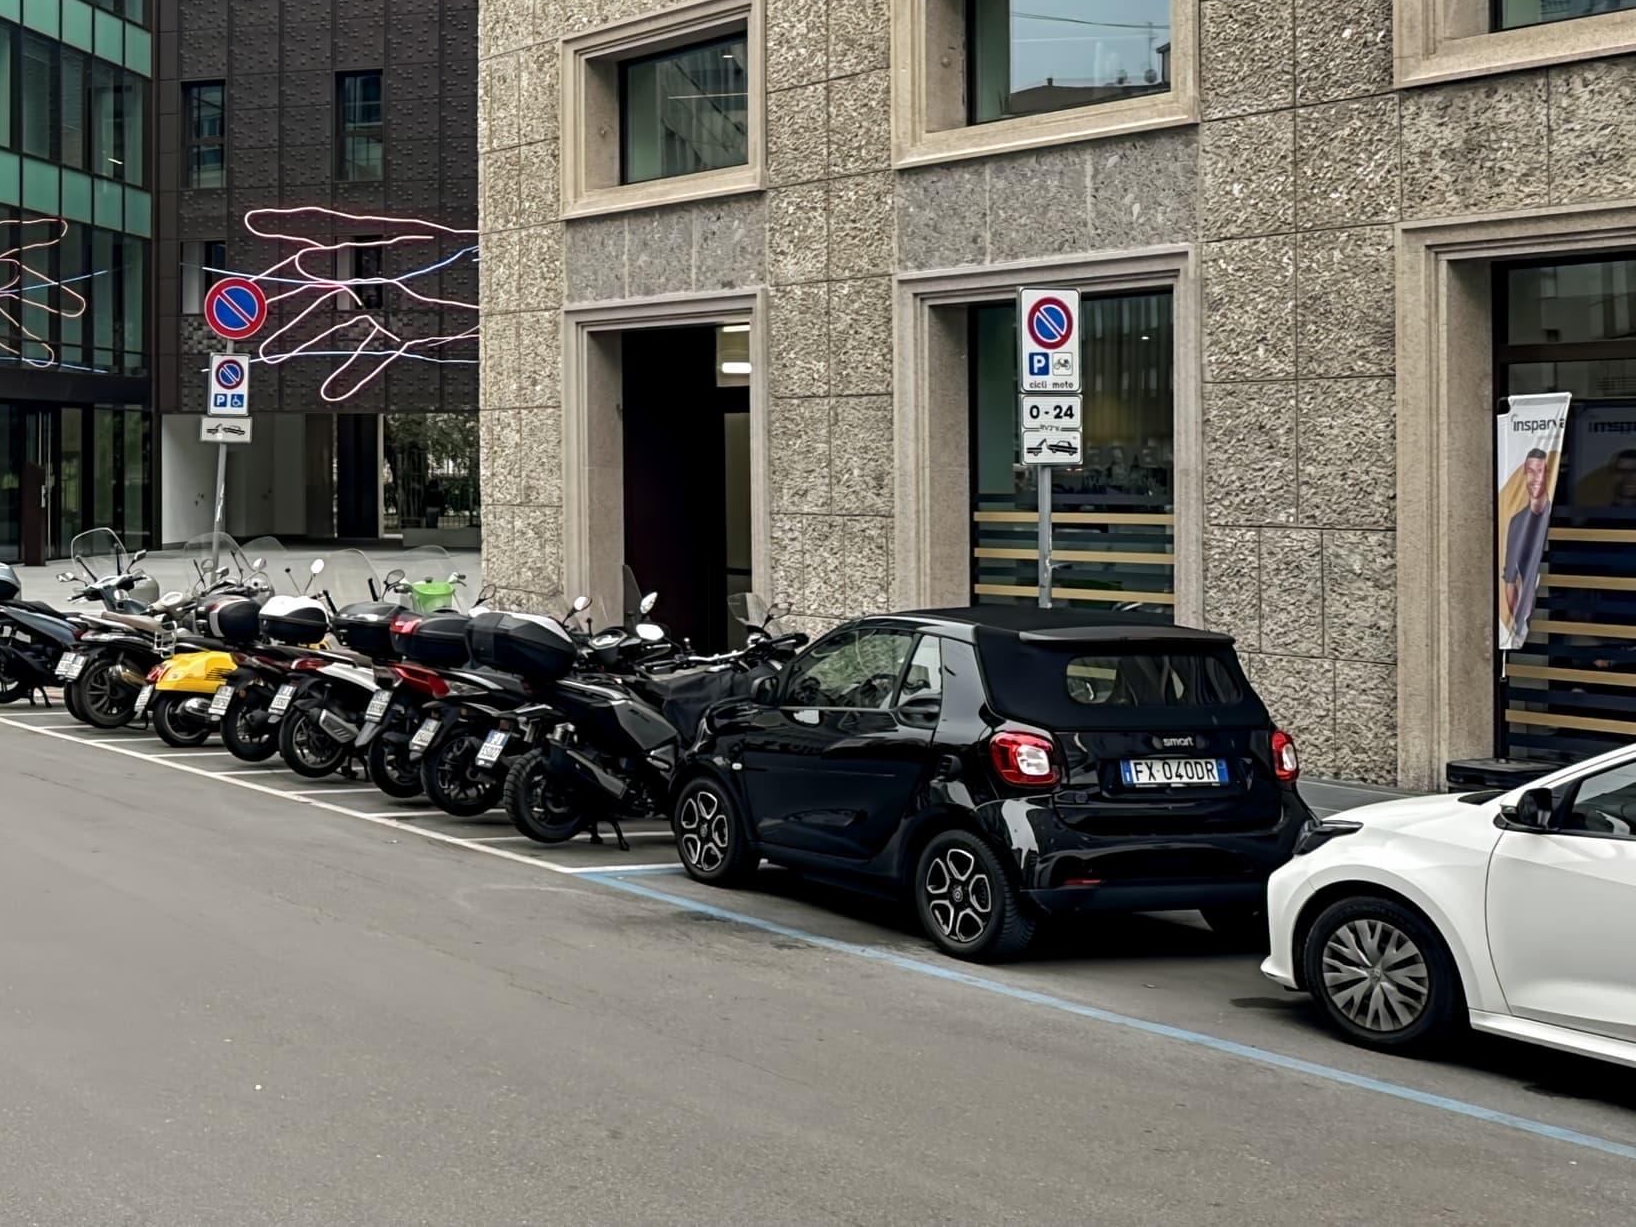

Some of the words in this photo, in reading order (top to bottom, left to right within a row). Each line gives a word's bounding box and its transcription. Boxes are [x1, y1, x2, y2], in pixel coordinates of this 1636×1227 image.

[1033, 355, 1046, 374] P
[1029, 381, 1047, 389] cicli
[1052, 381, 1074, 389] moto
[216, 395, 225, 406] P
[1029, 404, 1040, 419] 0
[1053, 404, 1075, 419] 24
[1163, 736, 1194, 746] smart
